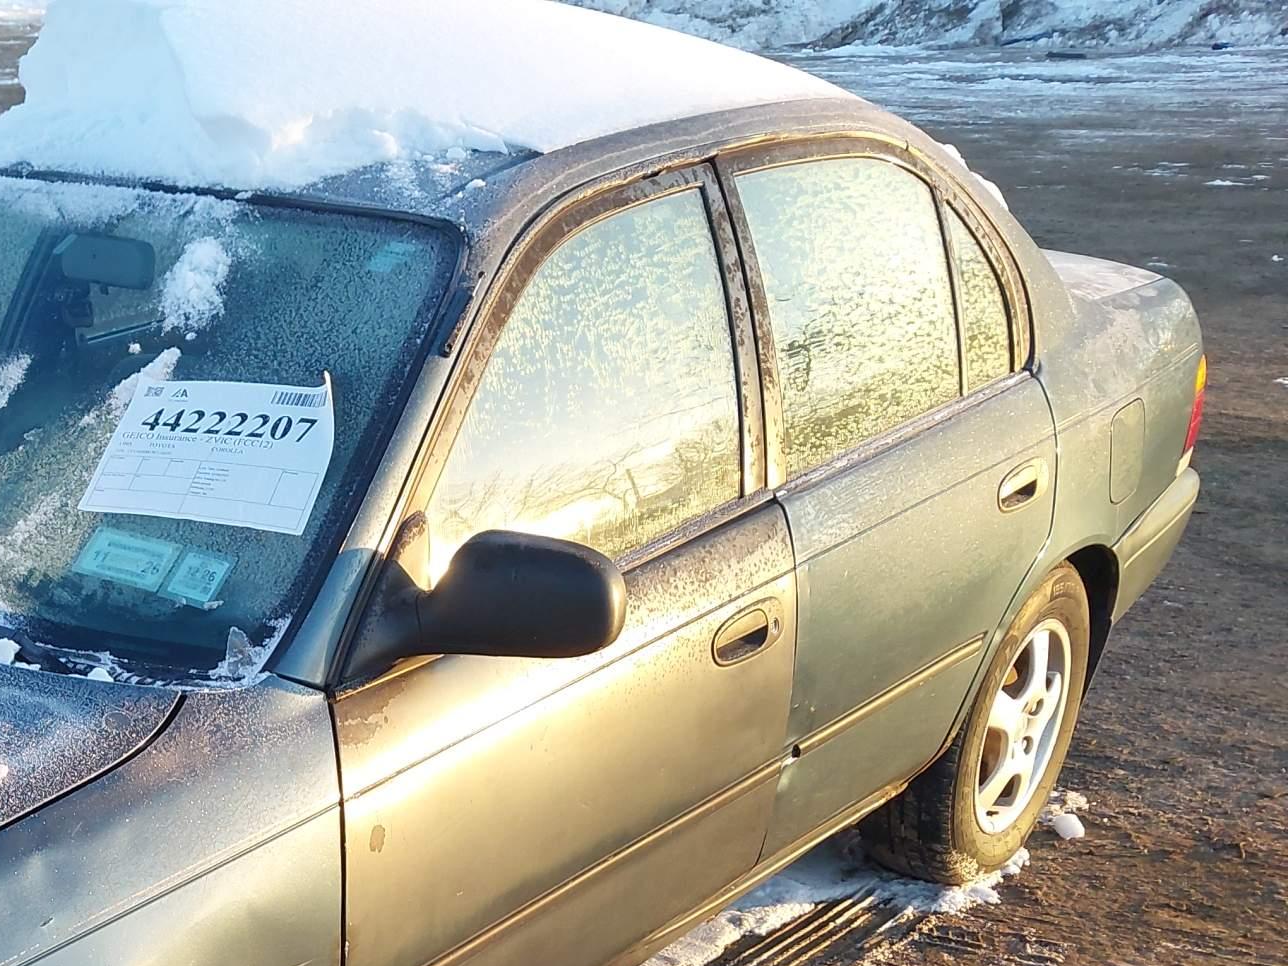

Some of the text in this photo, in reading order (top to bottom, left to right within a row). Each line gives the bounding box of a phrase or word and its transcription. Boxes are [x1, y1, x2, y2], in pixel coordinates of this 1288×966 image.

[122, 431, 155, 440] GEICO
[155, 433, 197, 443] Insurance
[141, 408, 318, 443] 44222207
